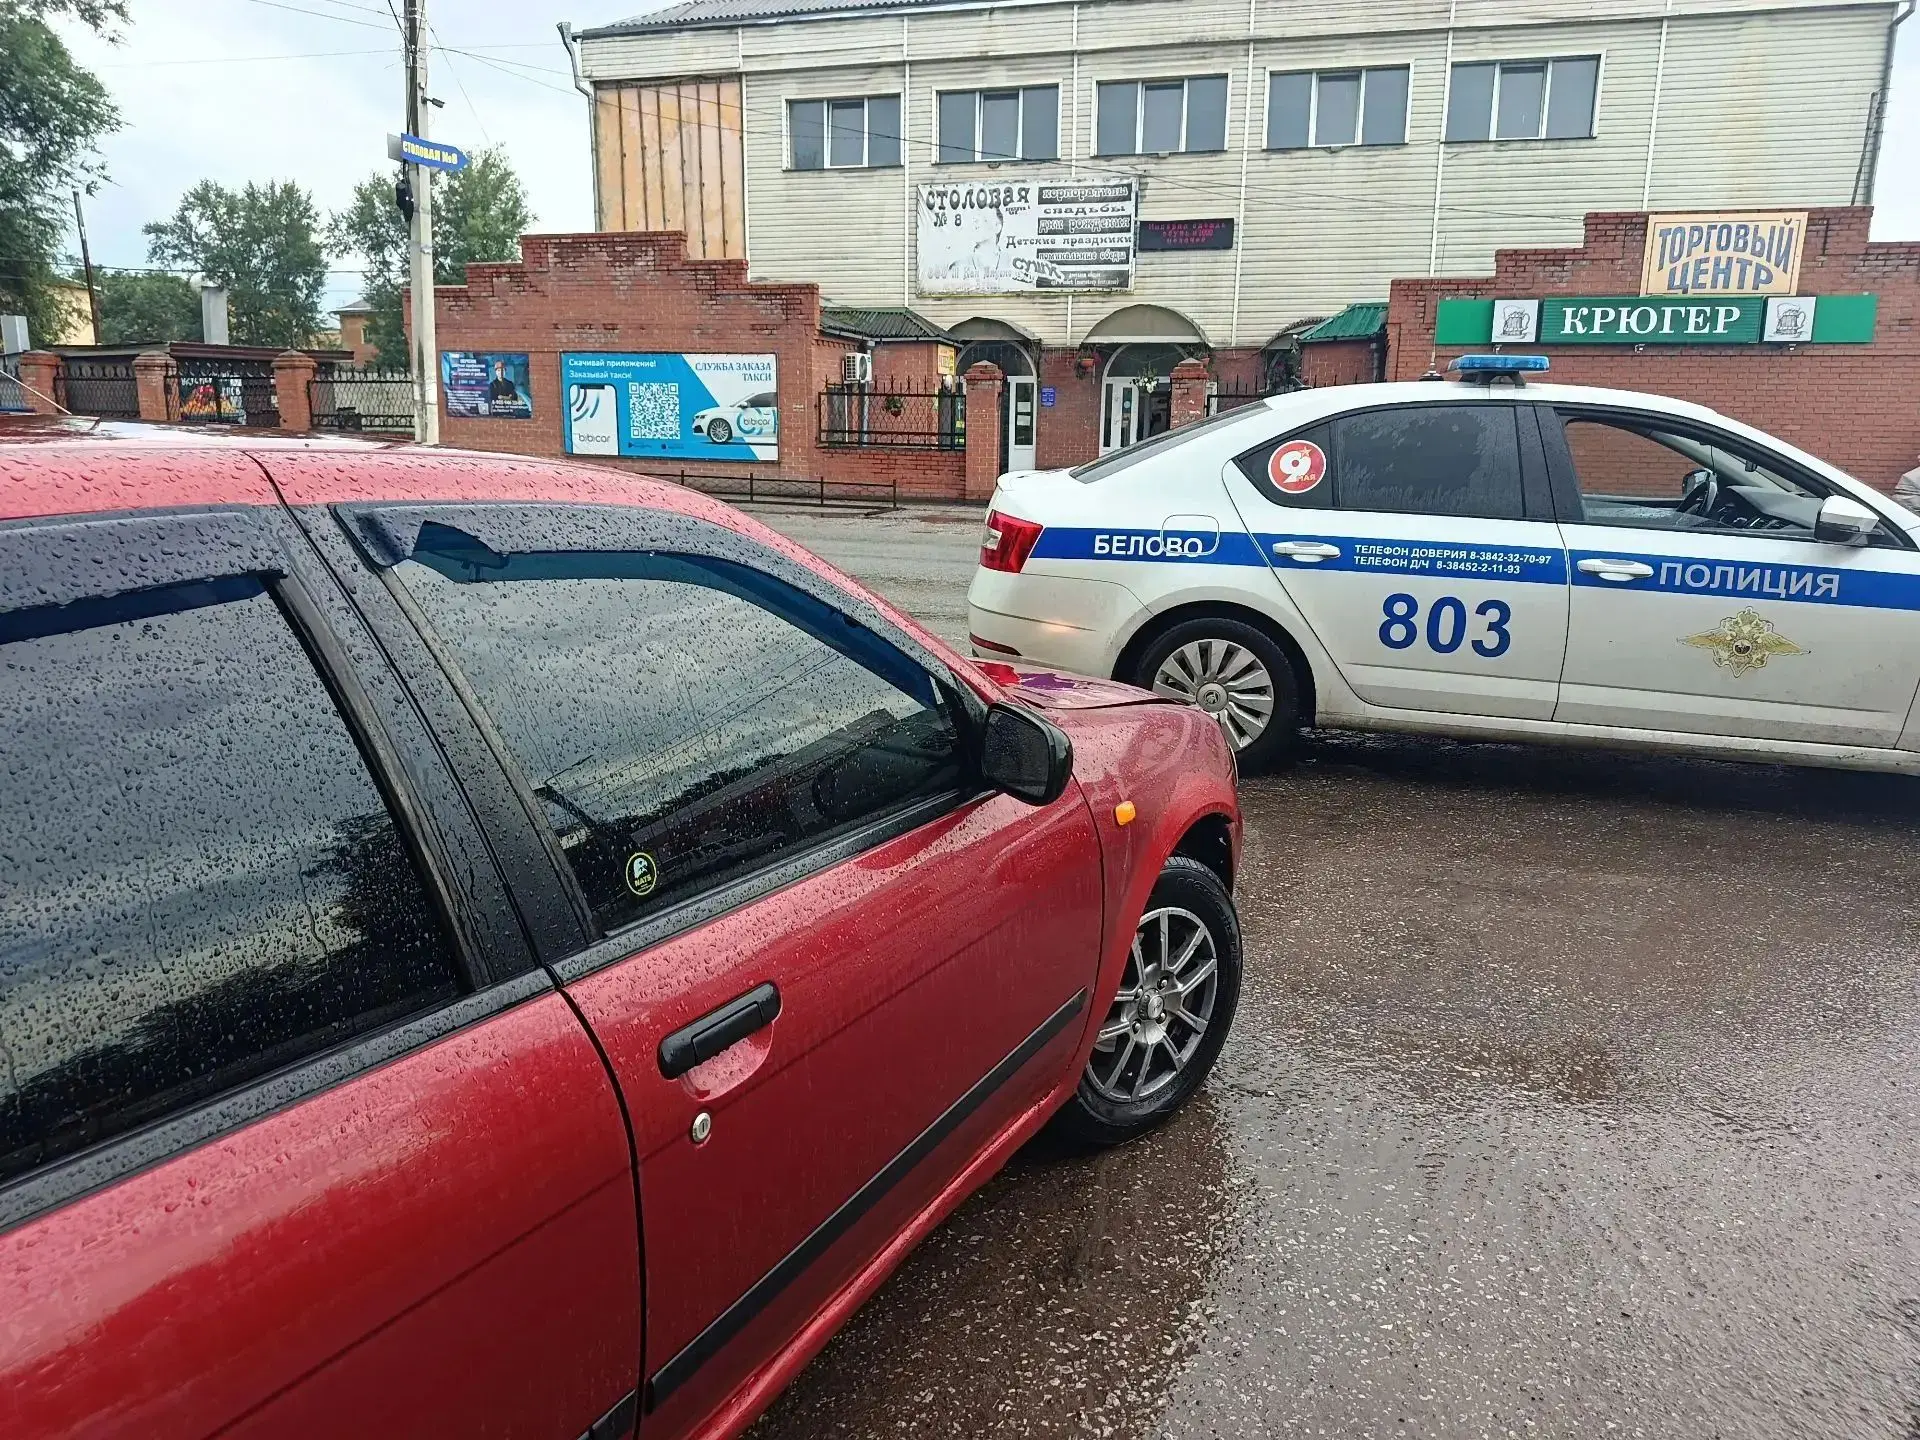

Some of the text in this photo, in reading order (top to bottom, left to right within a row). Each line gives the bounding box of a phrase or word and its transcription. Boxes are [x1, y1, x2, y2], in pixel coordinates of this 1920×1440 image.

[403, 141, 440, 161] СТОЛОВАЯ
[1042, 187, 1128, 201] корпоративы
[1043, 204, 1126, 216] свадьбы
[1039, 218, 1131, 234] дни рождения
[1006, 236, 1132, 249] Детские праздники
[1658, 216, 1796, 275] ТОРГОВЫЙ
[1038, 249, 1127, 263] поминальные обеды
[1667, 257, 1774, 294] ЦЕНТР
[1560, 306, 1741, 335] КРЮГЕР
[569, 358, 656, 368] Скачивай приложение!
[695, 362, 771, 371] СЛУЖБА ЗАКАЗА
[569, 370, 632, 379] Заказывай такси!
[742, 373, 772, 381] ТАКСИ
[1280, 450, 1312, 484] 9
[1094, 534, 1203, 558] БЕЛОВО
[1355, 544, 1552, 565] ТЕЛЕФОН ДОВЕРИЯ 8-3842-32-70-97
[1354, 556, 1521, 574] ТЕЛЕФОН Д/Ч 8-38452-2-11-93
[1659, 562, 1840, 598] ПОЛИЦИЯ
[1378, 593, 1513, 658] 803
